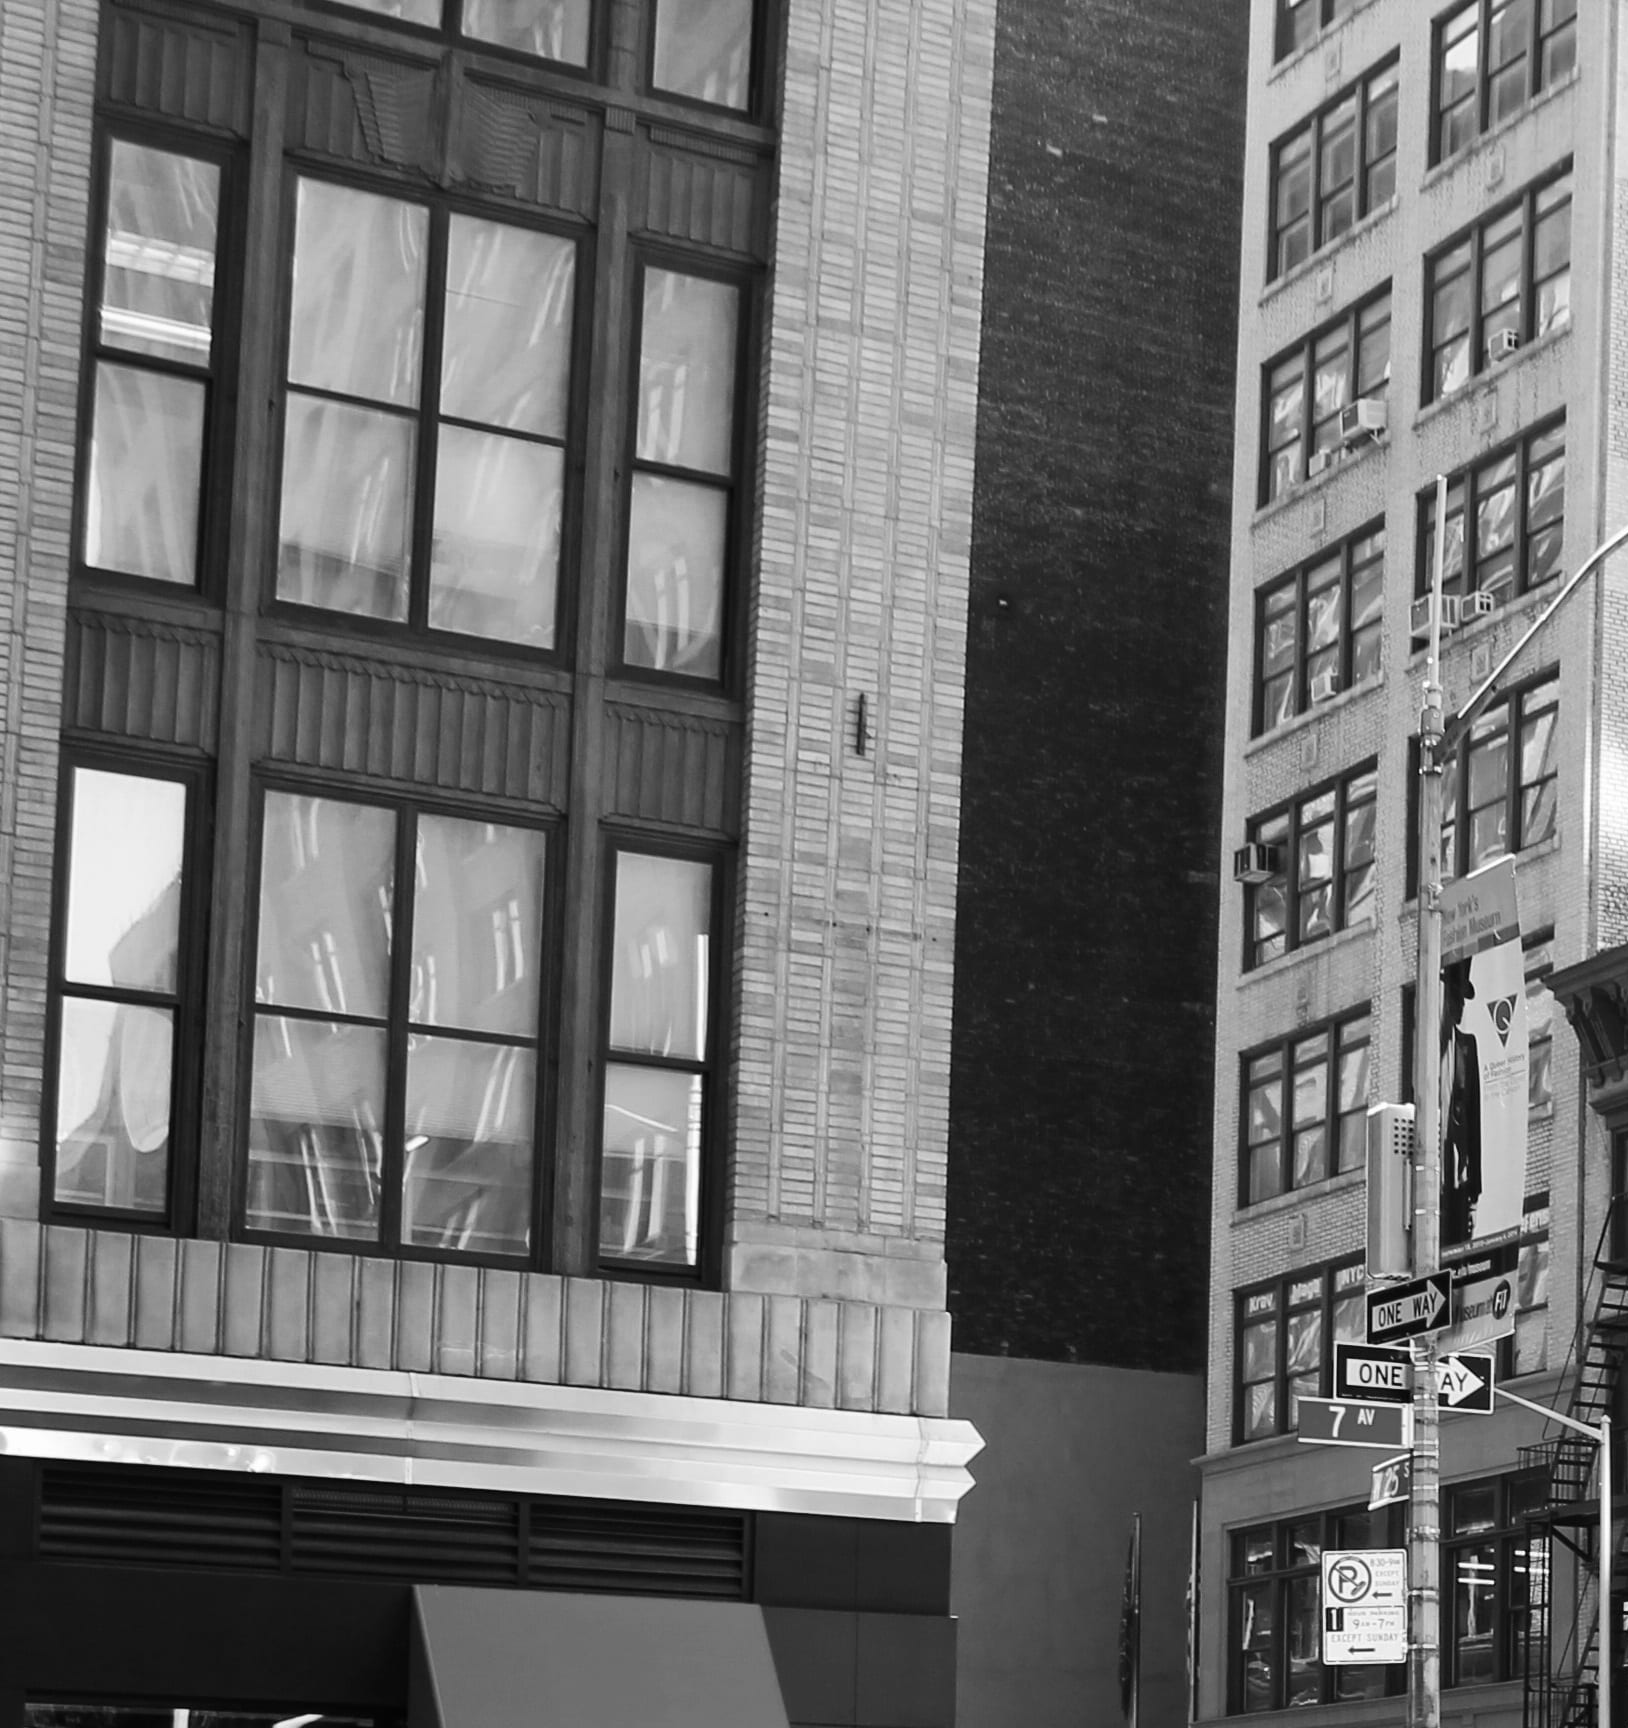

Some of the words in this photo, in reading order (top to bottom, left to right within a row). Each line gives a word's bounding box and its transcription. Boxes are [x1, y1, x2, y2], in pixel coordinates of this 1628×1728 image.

[1378, 1301, 1403, 1328] ONE
[1412, 1290, 1439, 1319] WAY
[1359, 1362, 1404, 1387] ONE
[1439, 1372, 1469, 1393] AY
[1328, 1405, 1346, 1438] 7
[1357, 1408, 1375, 1426] AV
[1383, 1463, 1400, 1498] 25
[1331, 1634, 1361, 1643] EXCEPT
[1366, 1632, 1398, 1642] SUNDAY
